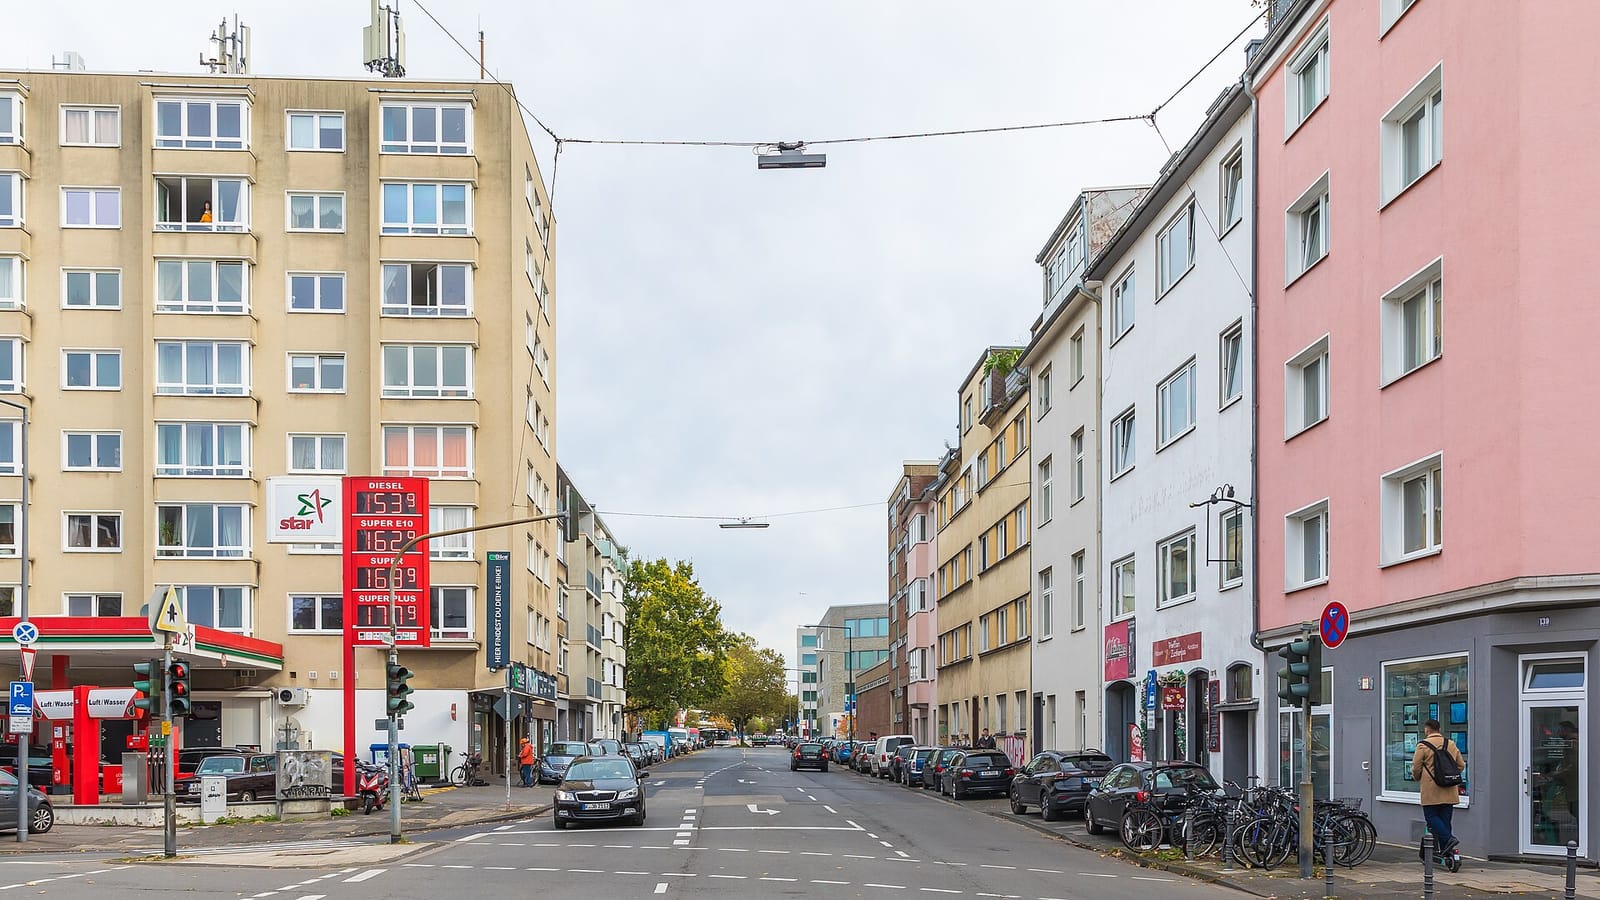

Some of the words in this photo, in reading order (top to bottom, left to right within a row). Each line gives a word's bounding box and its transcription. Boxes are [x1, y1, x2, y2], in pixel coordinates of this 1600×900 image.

[368, 482, 404, 490] DIESEL
[279, 516, 314, 530] star
[360, 519, 393, 527] SUPER
[395, 519, 414, 527] E10
[358, 594, 390, 603] SUPER
[494, 607, 502, 618] DU
[494, 618, 502, 646] FINDEST
[494, 647, 502, 663] HIER
[13, 684, 24, 698] P
